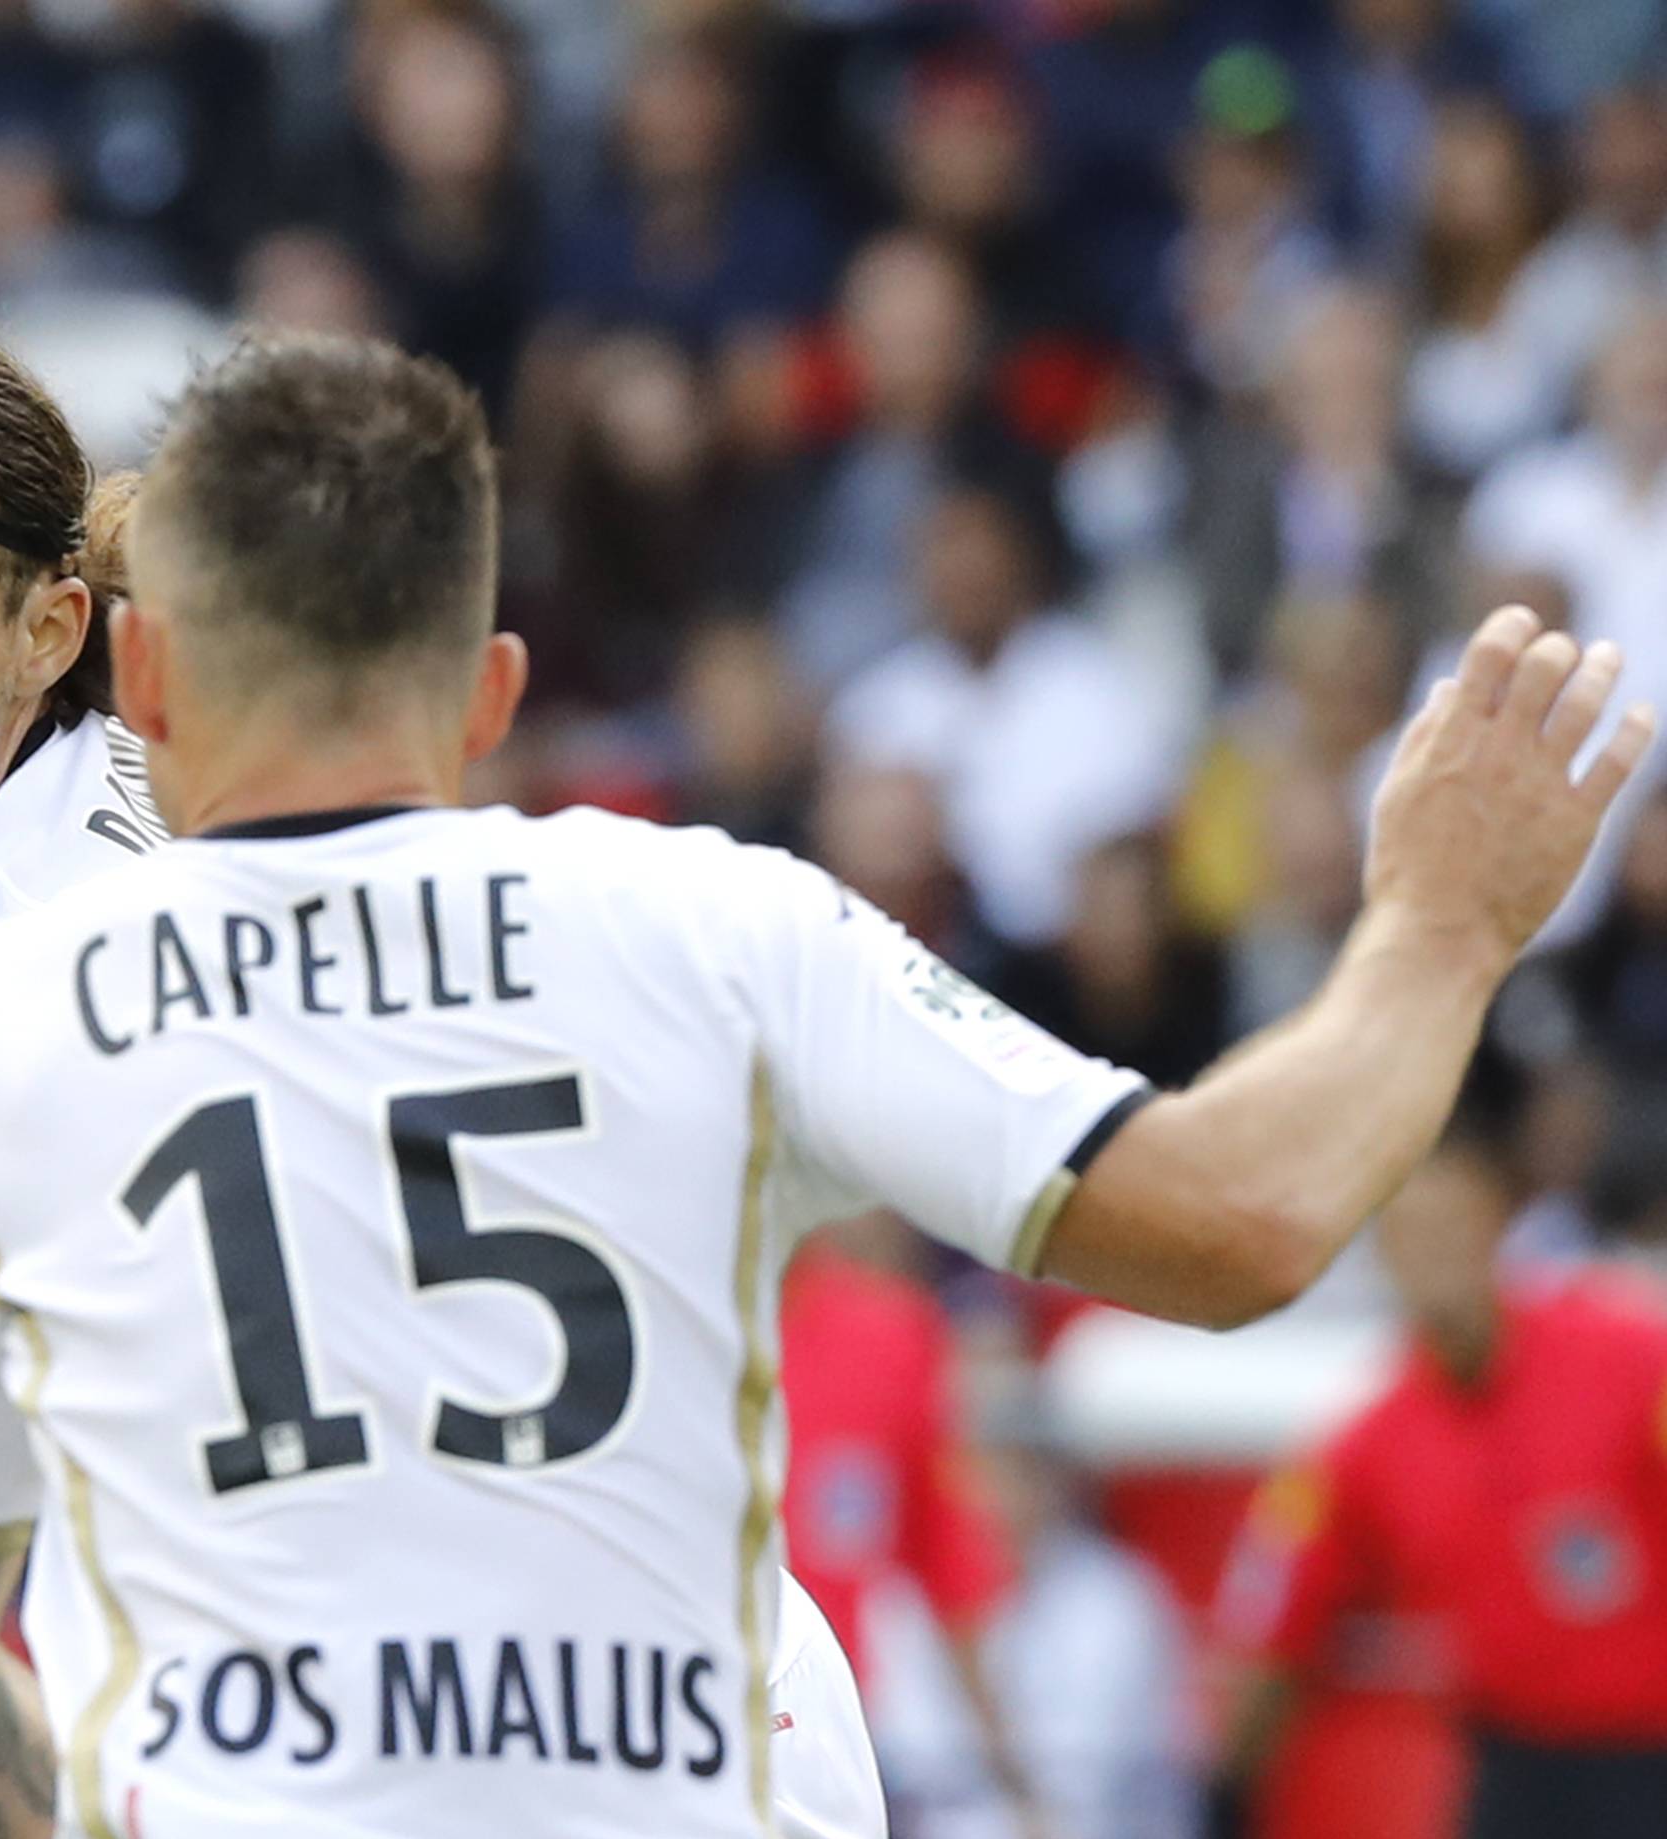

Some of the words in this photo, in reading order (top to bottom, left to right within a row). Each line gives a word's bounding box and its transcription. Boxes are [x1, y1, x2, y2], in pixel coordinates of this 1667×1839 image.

[75, 872, 535, 1057] CAPELLE
[119, 1071, 637, 1498] 15
[141, 1642, 340, 1765] SOS
[377, 1637, 728, 1779] MALUS
